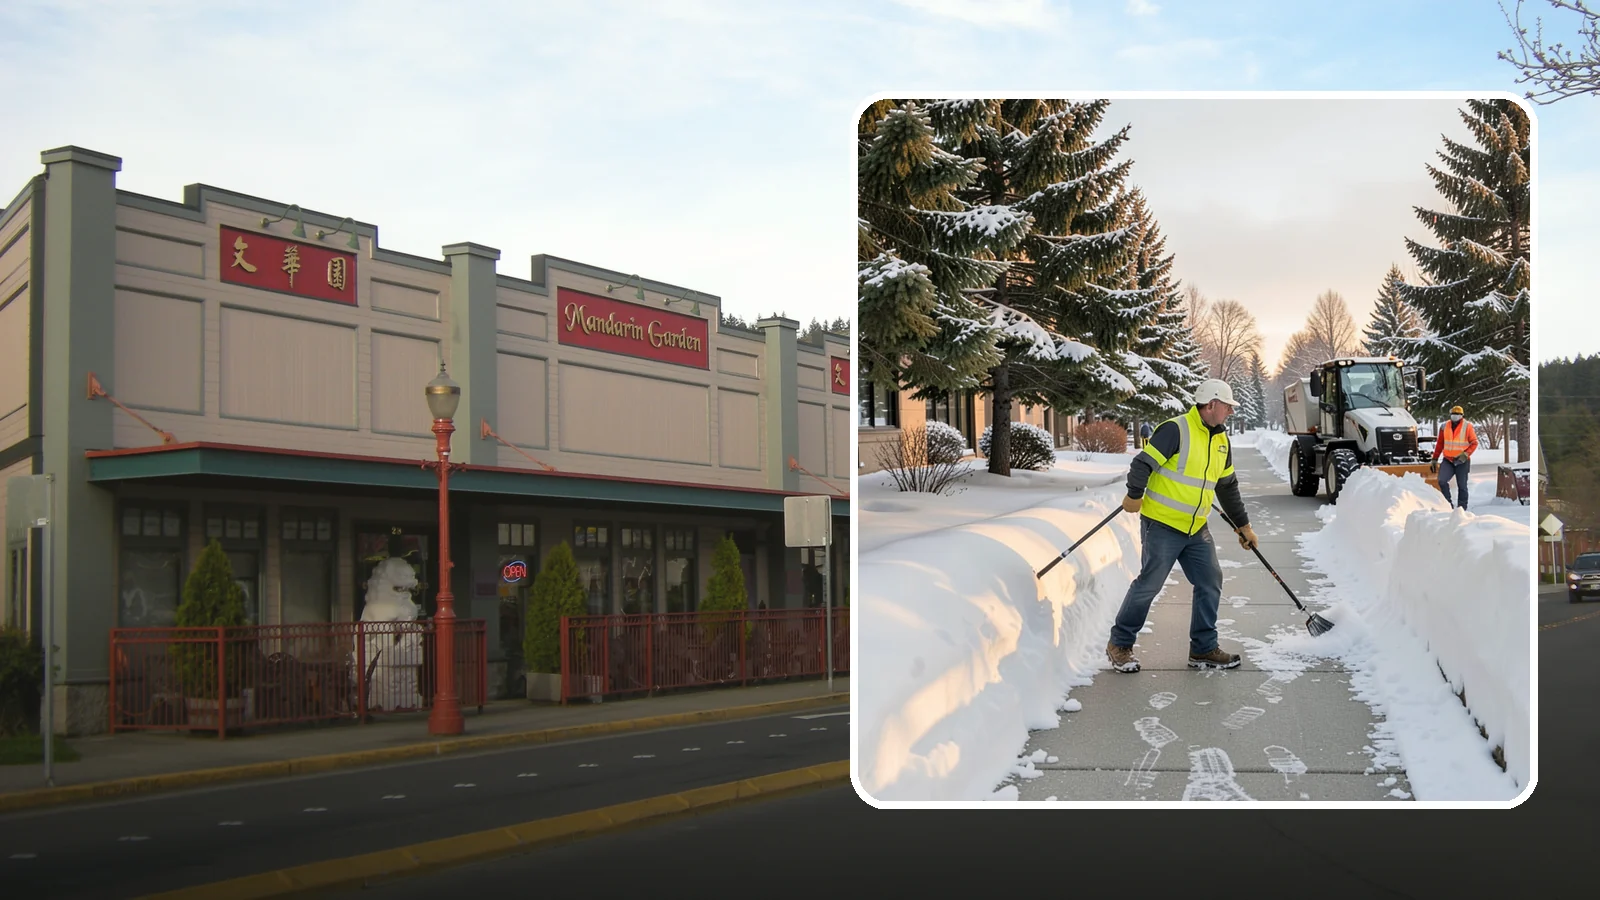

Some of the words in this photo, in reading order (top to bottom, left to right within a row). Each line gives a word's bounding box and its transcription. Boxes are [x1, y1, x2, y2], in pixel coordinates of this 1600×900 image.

[231, 236, 346, 291] 文華園
[564, 302, 644, 341] Mandarin
[648, 320, 701, 352] Garden
[834, 363, 846, 386] 文
[503, 565, 527, 578] OPEN
